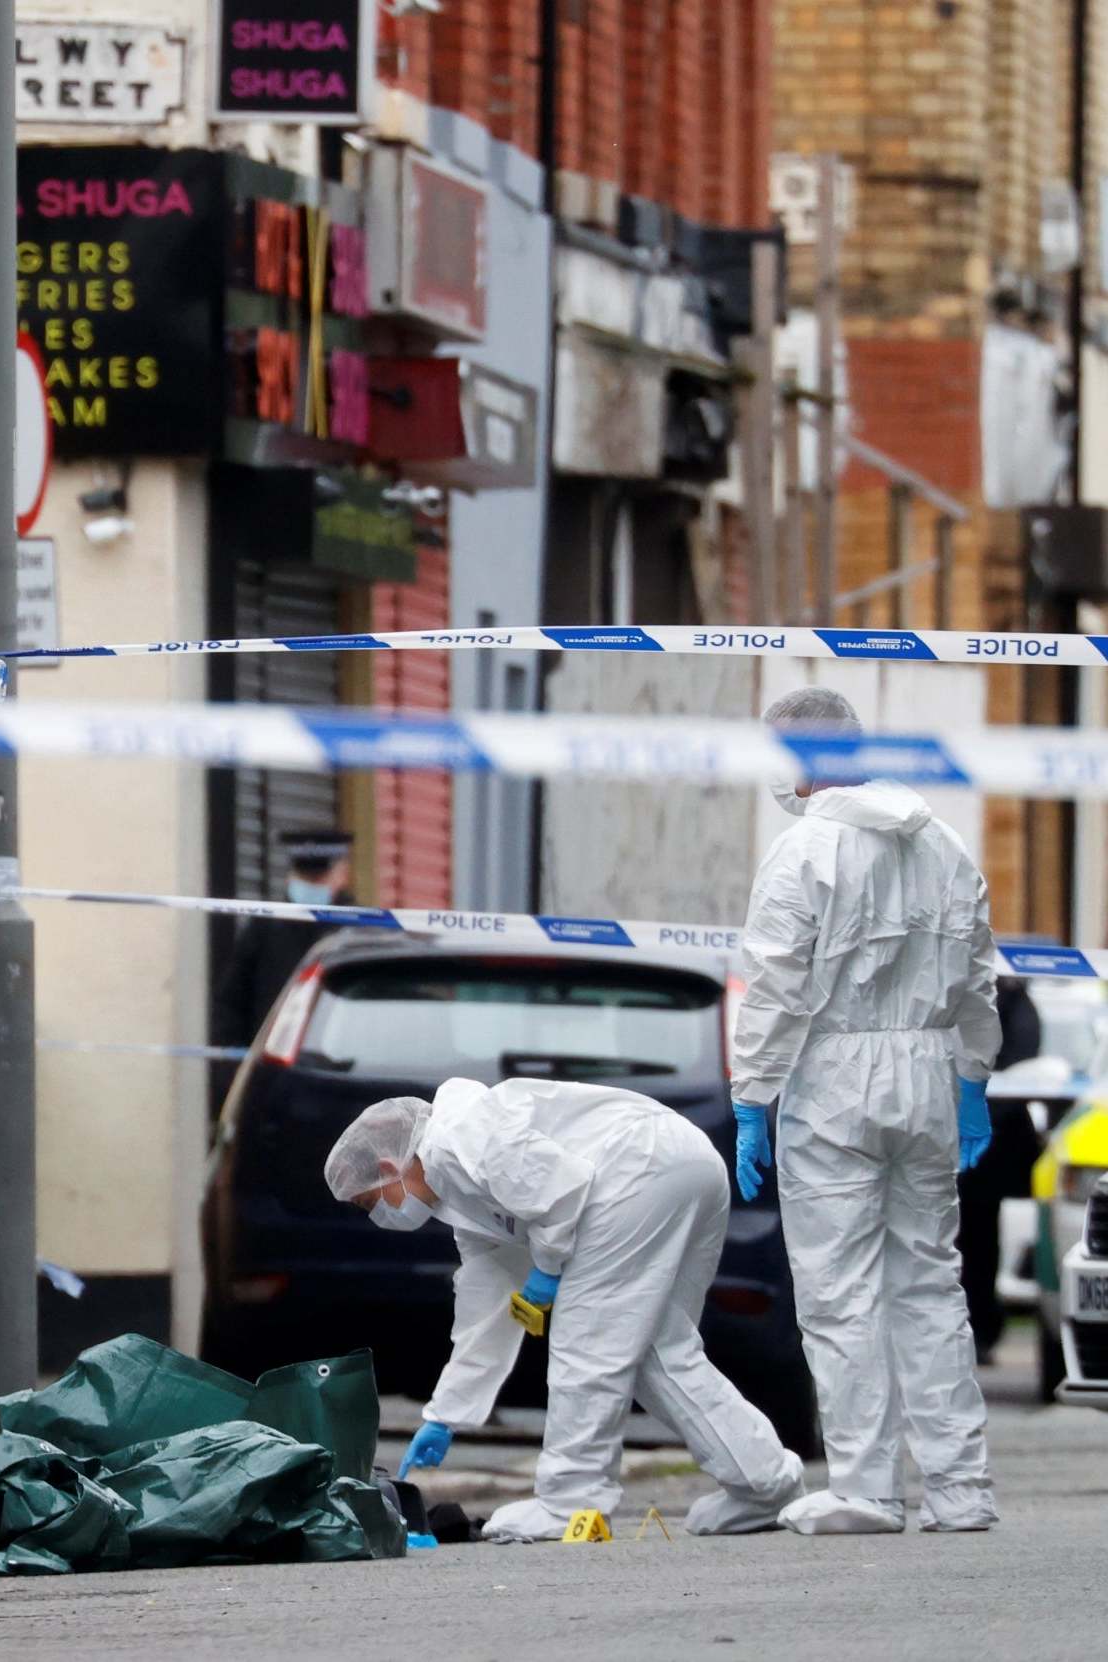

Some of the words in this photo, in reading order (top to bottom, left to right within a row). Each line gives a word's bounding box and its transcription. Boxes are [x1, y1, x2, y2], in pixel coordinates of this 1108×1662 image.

[231, 20, 349, 51] SHUGA
[230, 68, 348, 99] SHUGA
[37, 179, 193, 218] SHUGA
[693, 633, 786, 649] POLICE
[966, 638, 1059, 657] POLICE
[427, 913, 507, 933] POLICE
[659, 927, 738, 949] POLICE
[573, 1516, 587, 1537] 6
